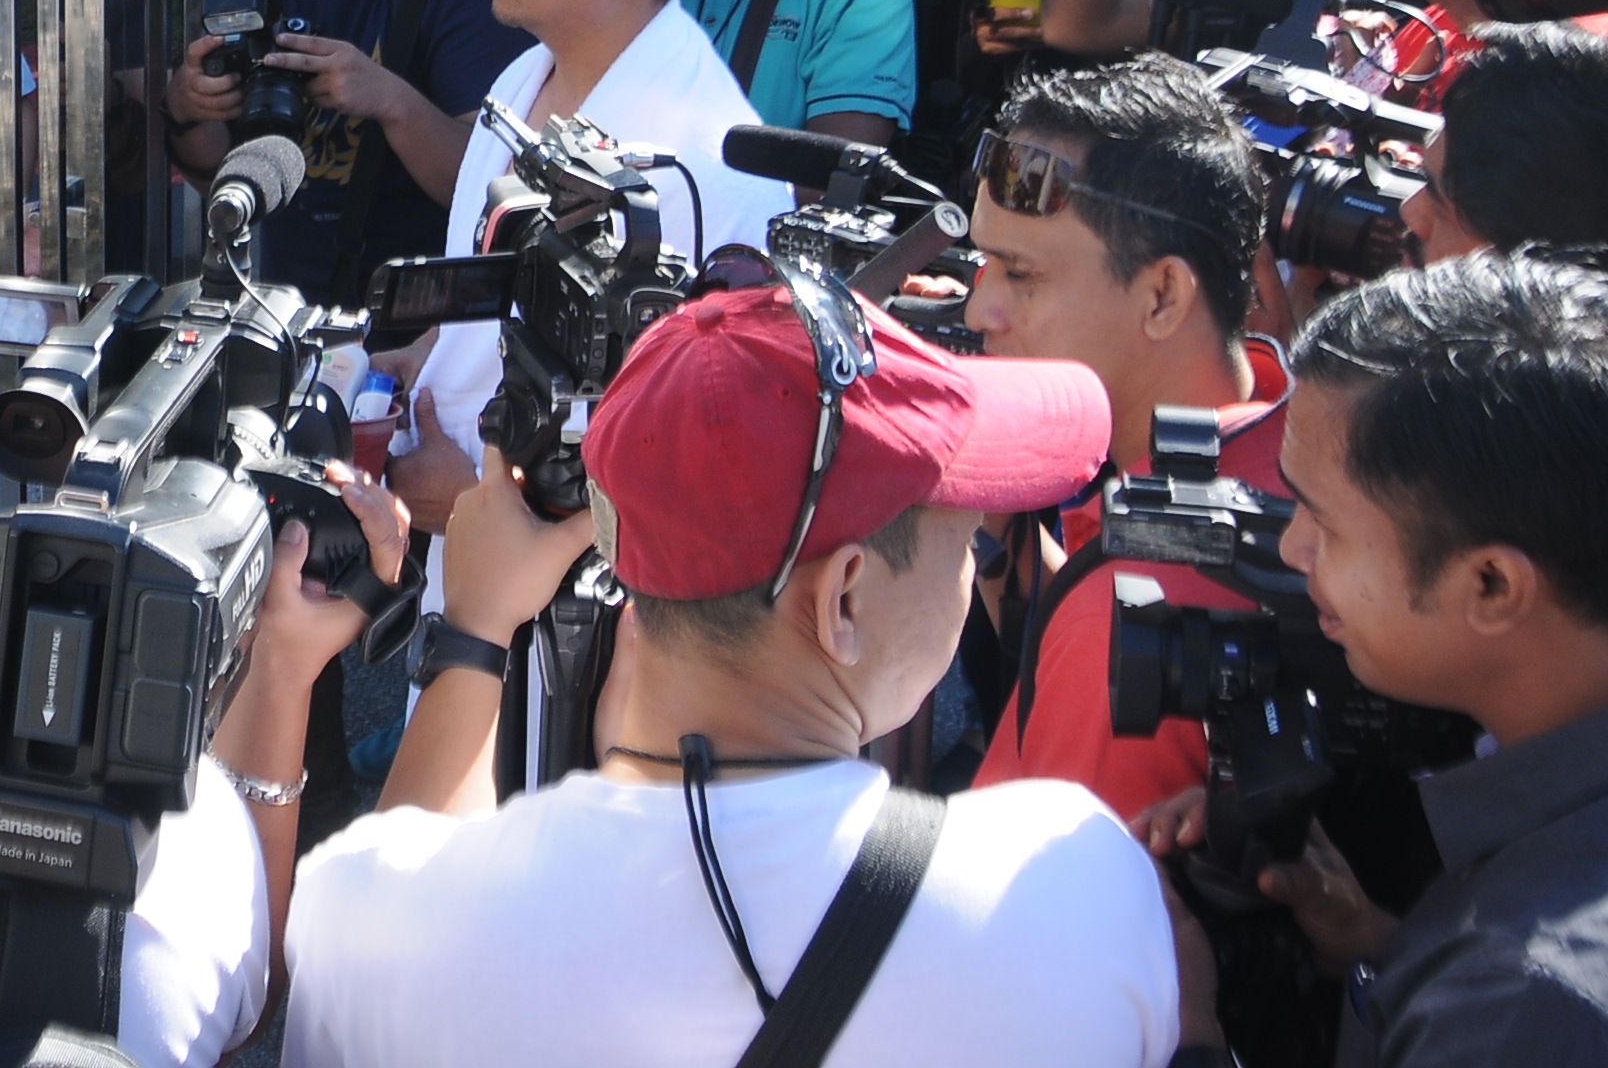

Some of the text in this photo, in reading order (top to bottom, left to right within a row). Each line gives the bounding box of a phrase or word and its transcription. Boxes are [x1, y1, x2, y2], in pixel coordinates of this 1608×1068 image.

[244, 548, 265, 601] HD
[52, 630, 62, 652] PACK
[48, 653, 59, 687] BATTERY
[25, 849, 36, 862] in
[39, 852, 73, 868] Japan
